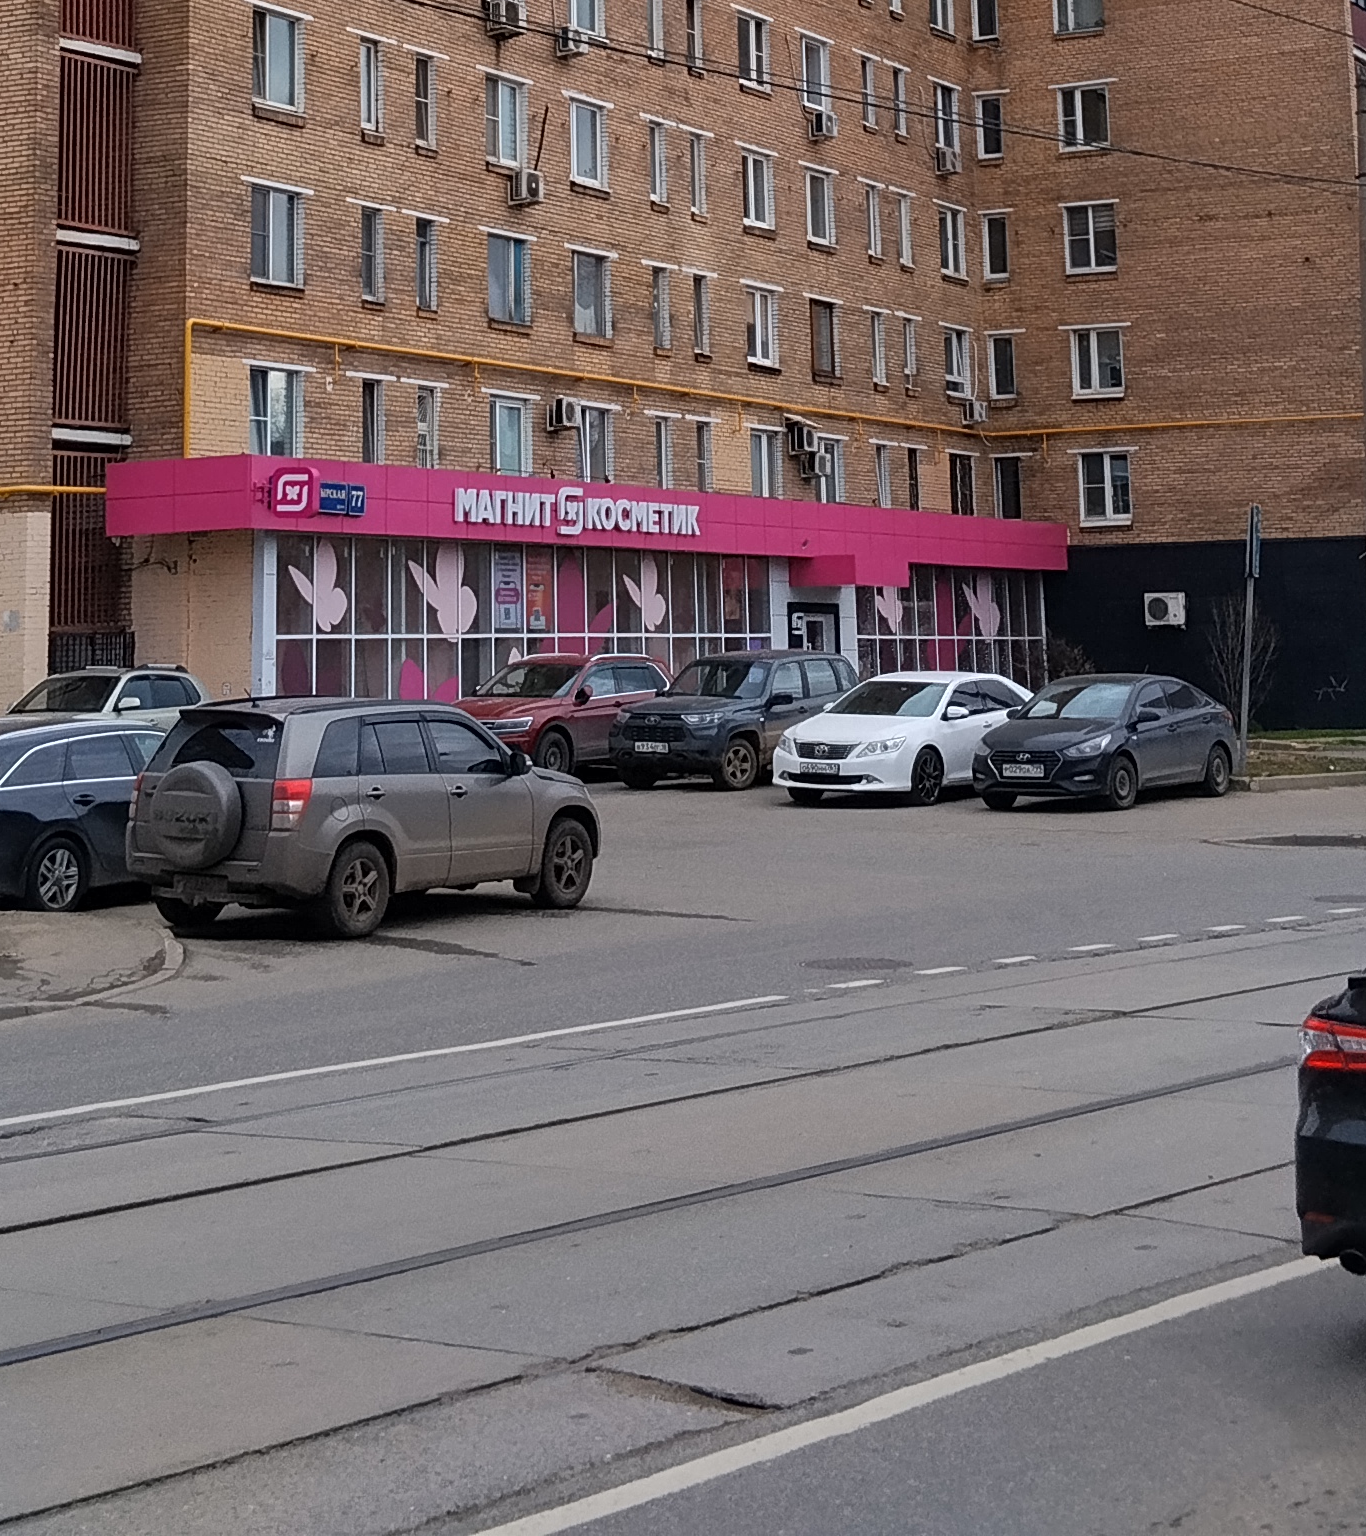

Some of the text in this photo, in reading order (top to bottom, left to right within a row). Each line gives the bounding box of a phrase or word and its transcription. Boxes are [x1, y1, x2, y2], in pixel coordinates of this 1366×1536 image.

[320, 488, 346, 500] ЫРСКАЯ
[351, 490, 364, 508] 77
[454, 487, 701, 536] МАГНИТ КОСМЕТИК
